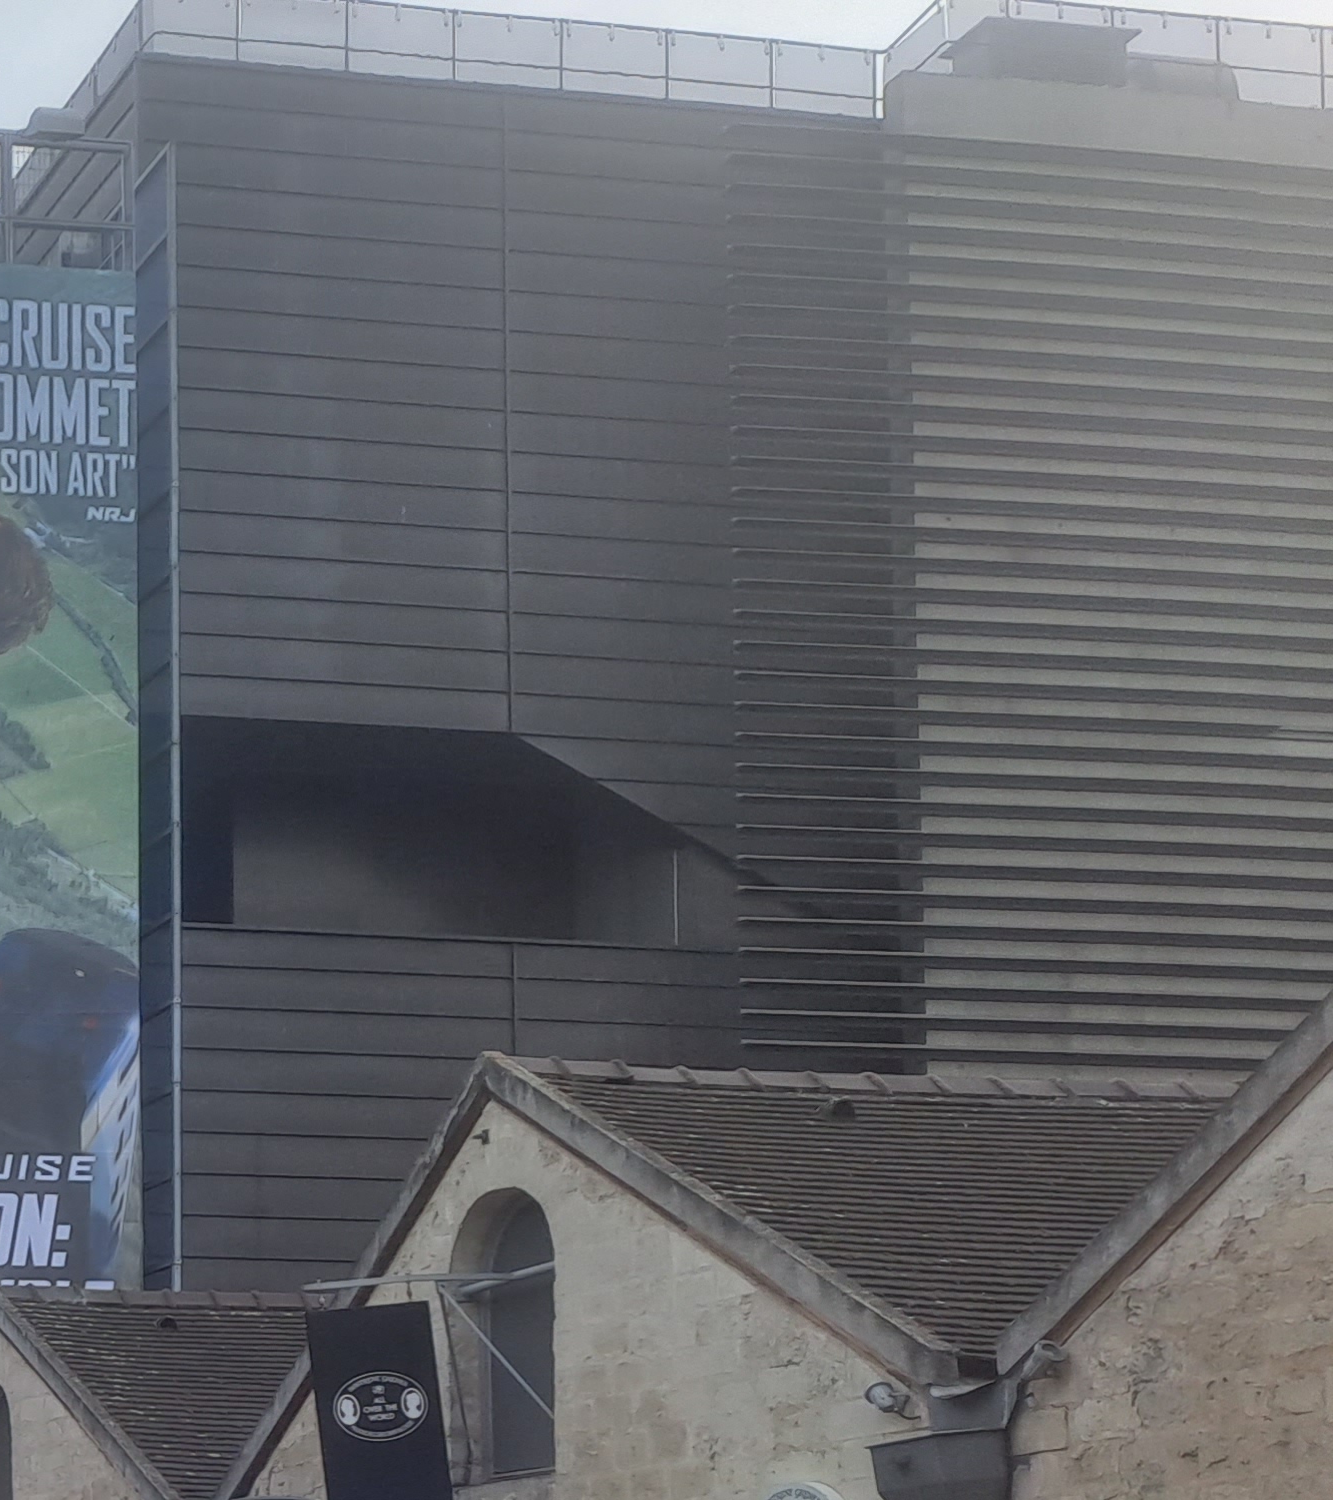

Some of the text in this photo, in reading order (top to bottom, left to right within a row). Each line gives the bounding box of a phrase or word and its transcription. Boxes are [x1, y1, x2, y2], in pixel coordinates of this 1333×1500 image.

[0, 448, 58, 496] SON
[66, 452, 135, 498] ART"
[86, 506, 136, 523] NRJ
